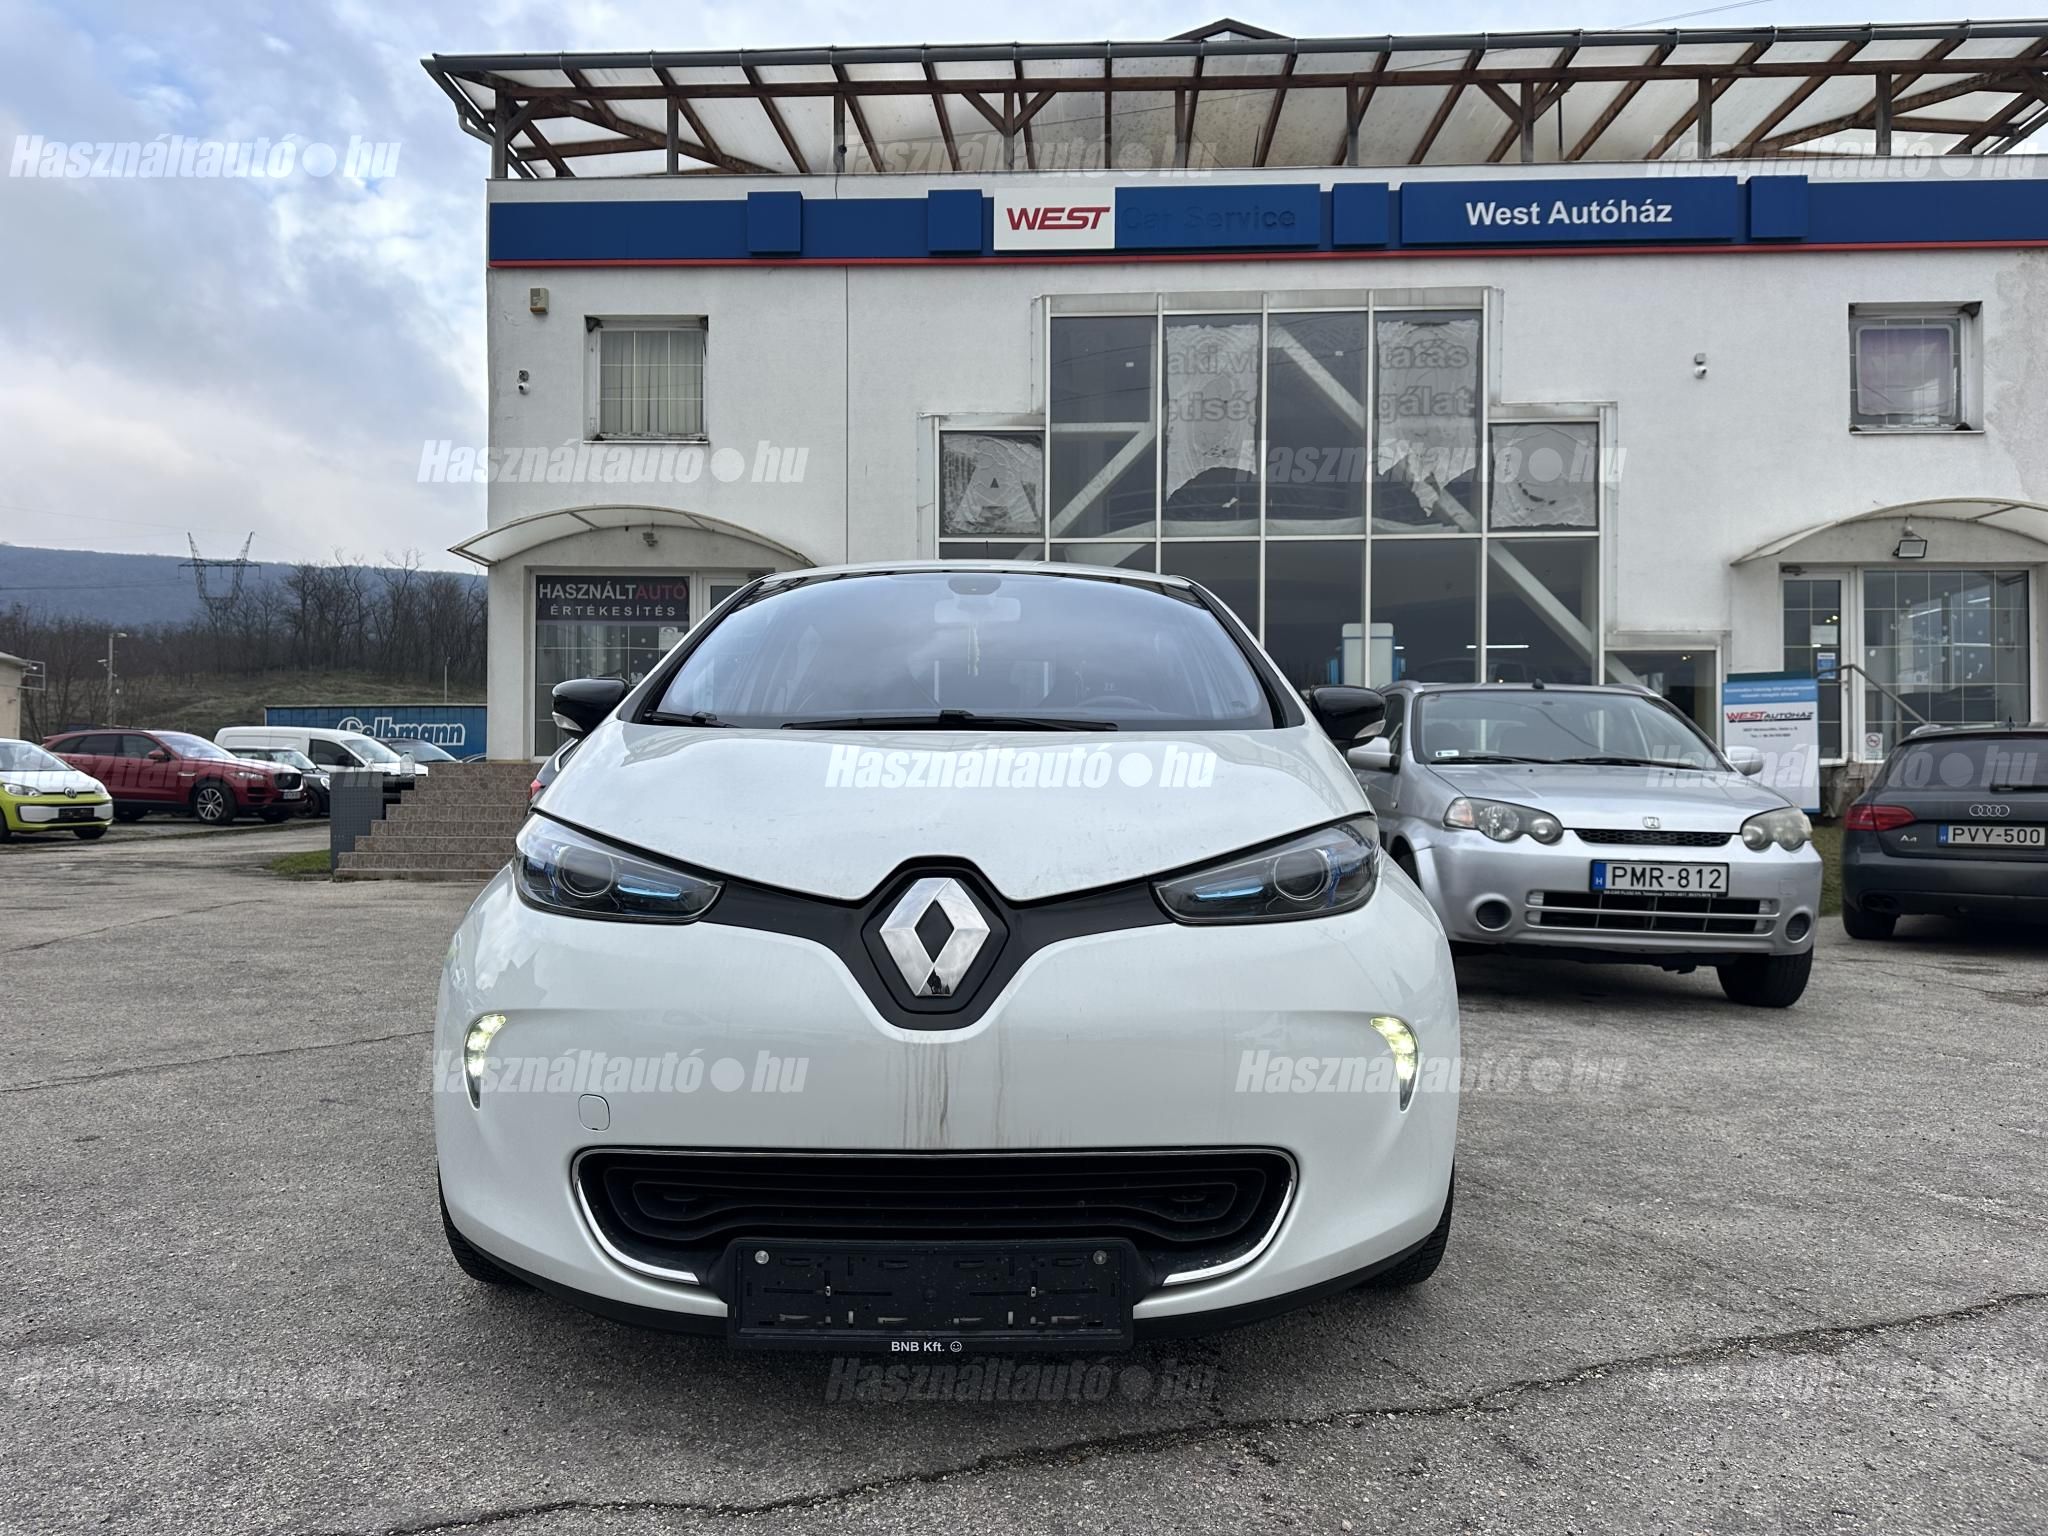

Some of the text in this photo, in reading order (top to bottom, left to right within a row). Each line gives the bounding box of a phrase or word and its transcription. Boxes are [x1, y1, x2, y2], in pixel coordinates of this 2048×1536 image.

[1006, 207, 1111, 230] WEST
[1466, 198, 1673, 226] West Autóház
[539, 580, 687, 599] HASZNÁLTAUTÓ
[550, 604, 676, 616] ÉRTÉKESÍTÉS
[1952, 827, 2041, 844] PVY-500
[1612, 866, 1722, 889] PMR-812
[891, 1341, 945, 1352] BNB Kft.
